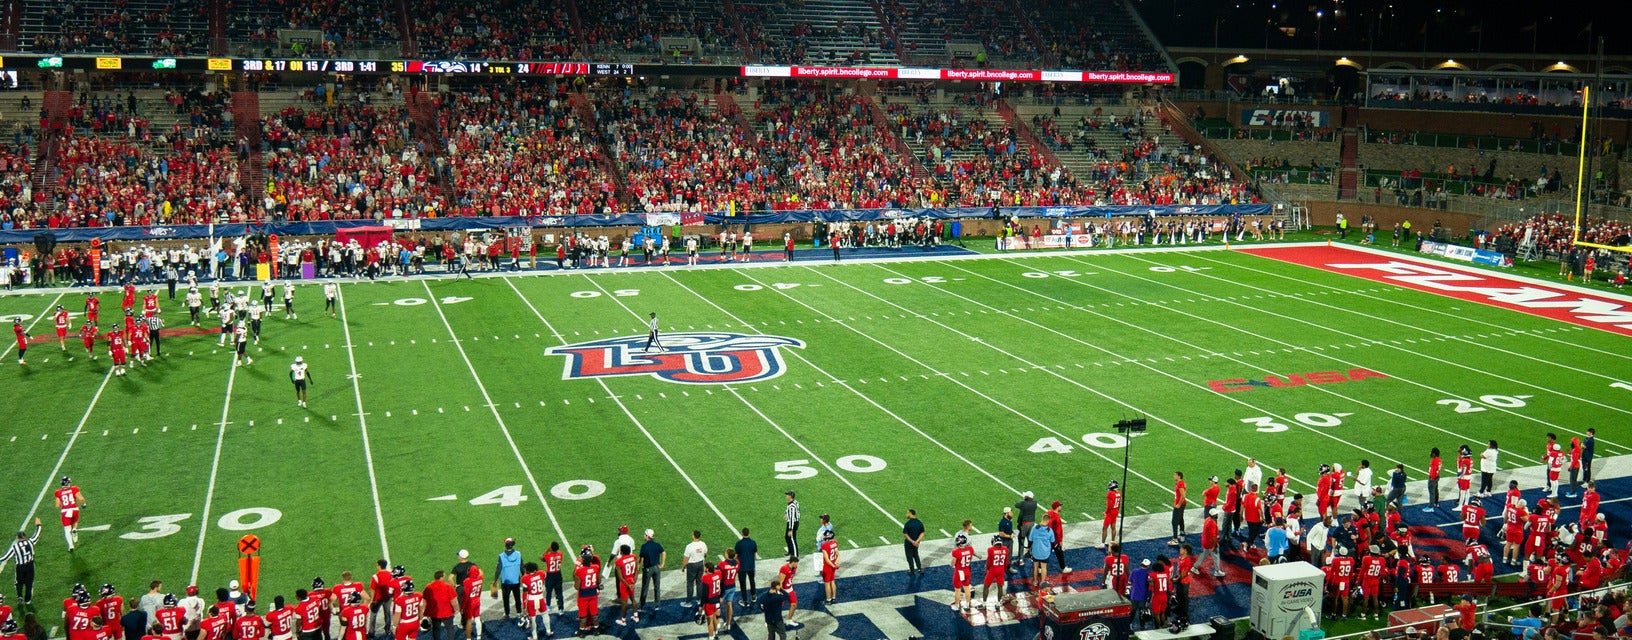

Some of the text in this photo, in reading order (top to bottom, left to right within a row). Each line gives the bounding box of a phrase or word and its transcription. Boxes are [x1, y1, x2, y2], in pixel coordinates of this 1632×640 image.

[243, 60, 263, 71] 3RD
[265, 61, 274, 71] &
[275, 61, 286, 71] 17
[290, 61, 303, 71] ON
[306, 61, 318, 71] 15
[335, 61, 354, 72] 3RD
[359, 62, 376, 72] 1:41
[391, 62, 404, 72] 35
[469, 63, 481, 73] 14
[518, 63, 530, 74] 24
[798, 67, 889, 77] liberty.spirit.bncollege.com
[947, 70, 1033, 79] liberty.spirit.bncollege.com
[1088, 73, 1170, 82] liberty.spirit.bncollege.com
[1435, 394, 1526, 413] 20
[1240, 412, 1342, 432] 30
[1027, 432, 1130, 454] 40
[774, 454, 887, 480] 50
[61, 493, 76, 506] 84
[469, 479, 607, 507] 40
[119, 507, 282, 539] 30
[1465, 511, 1476, 523] 18
[1536, 522, 1548, 533] 17
[960, 555, 971, 567] 45
[993, 554, 1006, 565] 23
[625, 561, 636, 576] 87
[727, 569, 737, 580] 17
[1338, 565, 1351, 577] 39
[1367, 564, 1381, 576] 28
[1537, 569, 1544, 581] 0
[1421, 571, 1433, 584] 22
[1446, 570, 1458, 583] 32
[530, 580, 543, 594] 38
[713, 580, 721, 594] 19
[1158, 578, 1167, 591] 14
[107, 607, 115, 619] 6
[307, 606, 320, 624] 52
[405, 603, 419, 617] 85
[72, 616, 89, 630] 73
[164, 617, 178, 631] 51
[279, 615, 292, 632] 50
[352, 614, 365, 629] 48
[241, 625, 255, 639] 13
